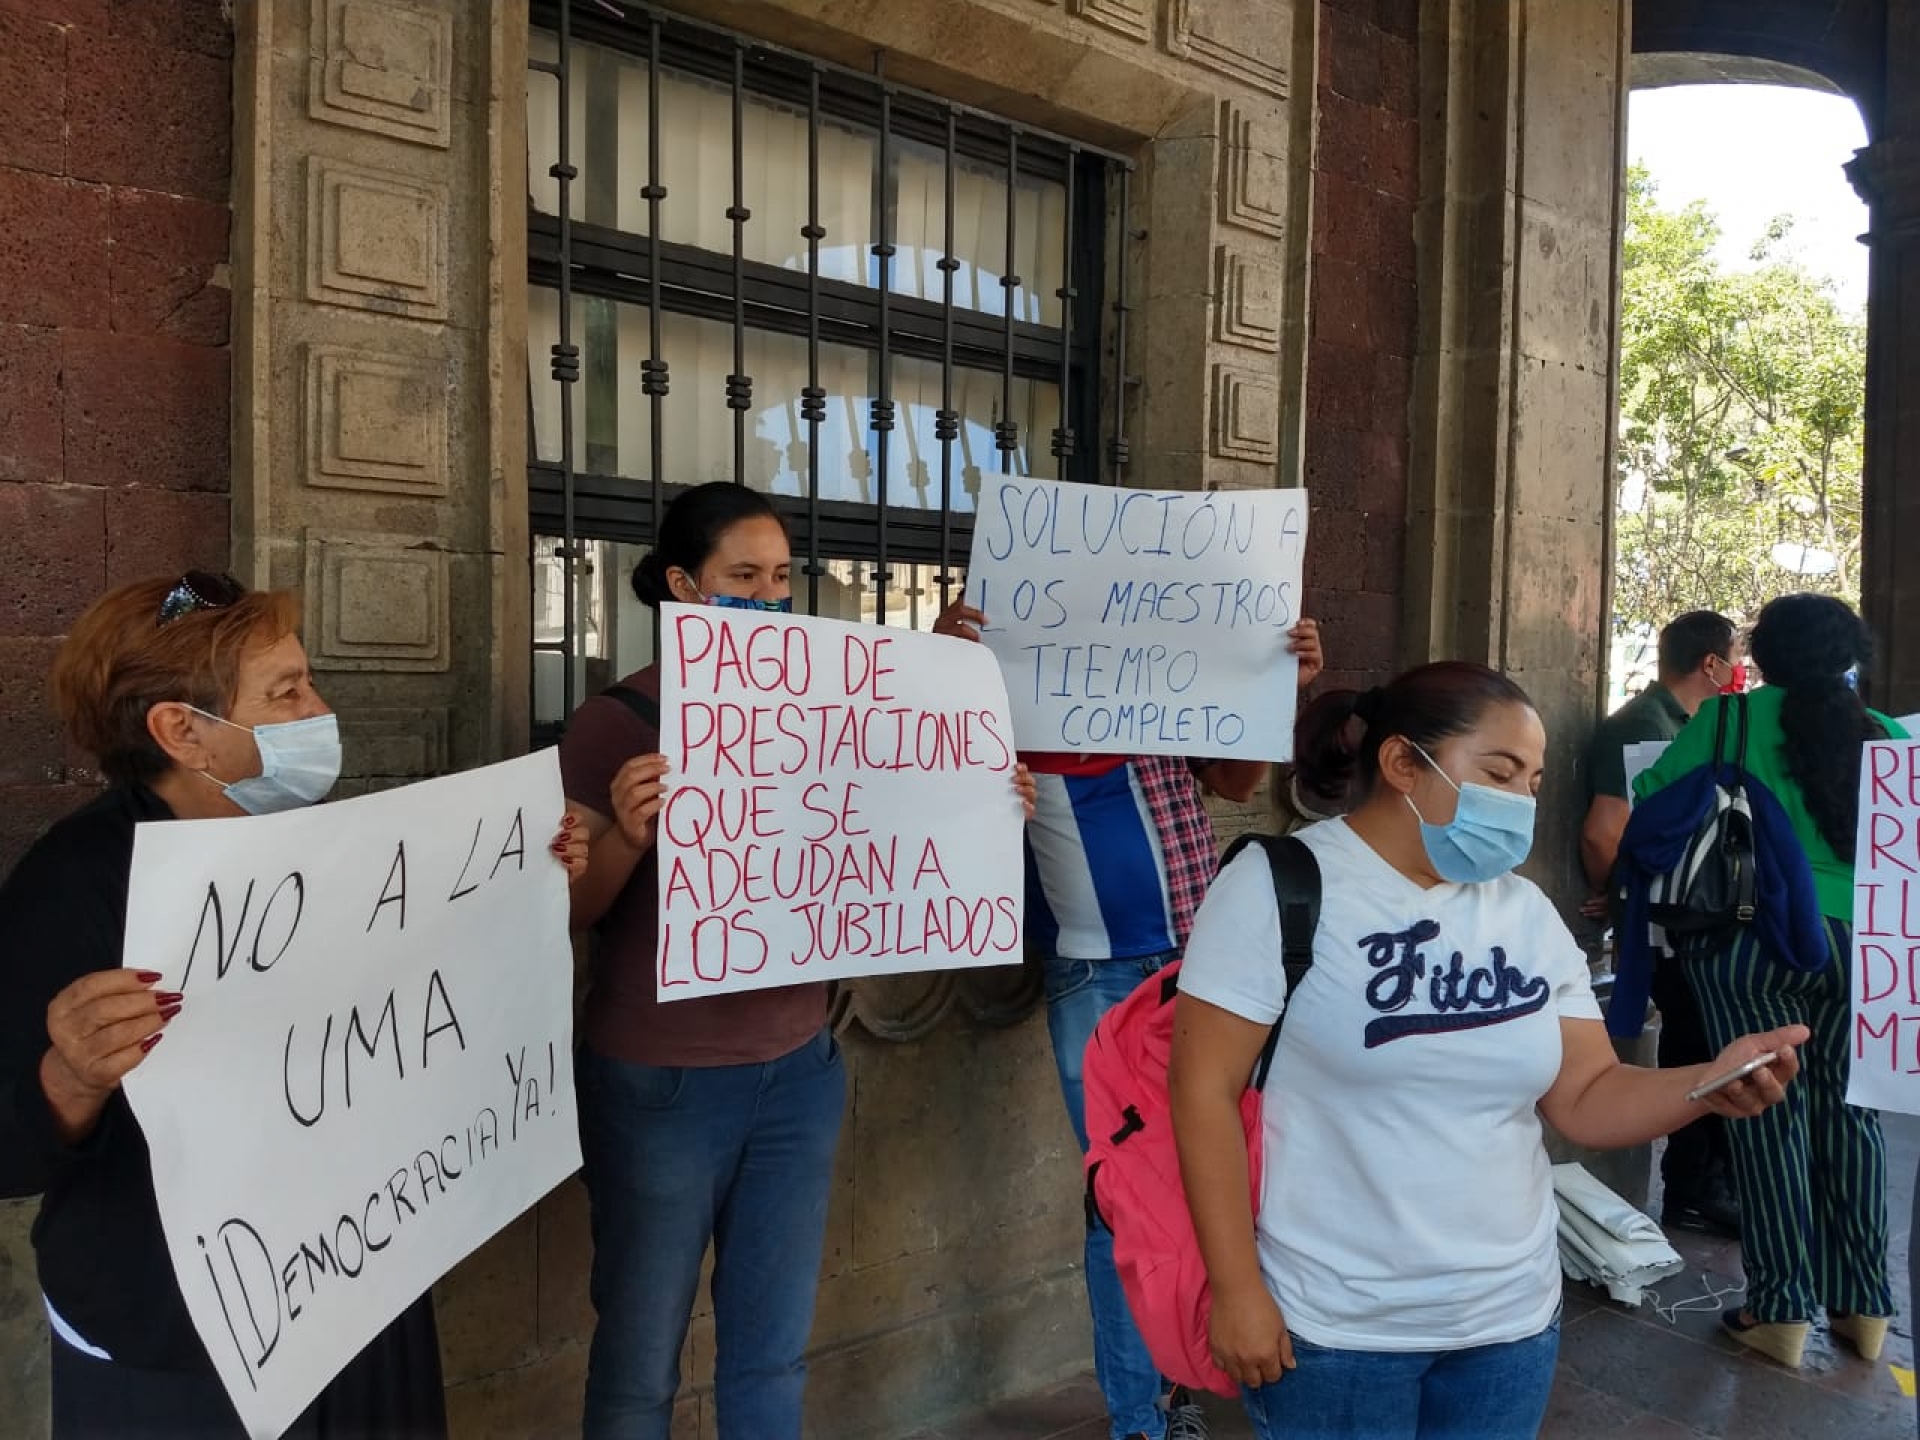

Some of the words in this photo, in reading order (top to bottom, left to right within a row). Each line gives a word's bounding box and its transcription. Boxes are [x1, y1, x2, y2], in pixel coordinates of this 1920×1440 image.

[986, 484, 1255, 561] SOLUCIÓN
[1278, 506, 1300, 561] A
[980, 578, 1068, 632] LOS
[1101, 577, 1291, 630] MAESTROS
[675, 613, 811, 696] PAGO
[843, 634, 896, 701] DE
[1020, 643, 1198, 705] TIEMPO
[679, 701, 1010, 778] PRESTACIONES
[1060, 702, 1245, 746] COMPLETO
[665, 785, 784, 858] QUE
[800, 782, 870, 842] SE
[1870, 812, 1920, 873] R
[181, 870, 304, 992] NO
[366, 839, 405, 933] A
[448, 807, 525, 902] LA
[666, 834, 897, 912] ADEUDAN
[912, 836, 950, 890] A
[661, 909, 769, 988] LOS
[790, 896, 1019, 966] JUBILADOS
[1357, 918, 1550, 1013] Fitch
[284, 968, 465, 1127] UMA
